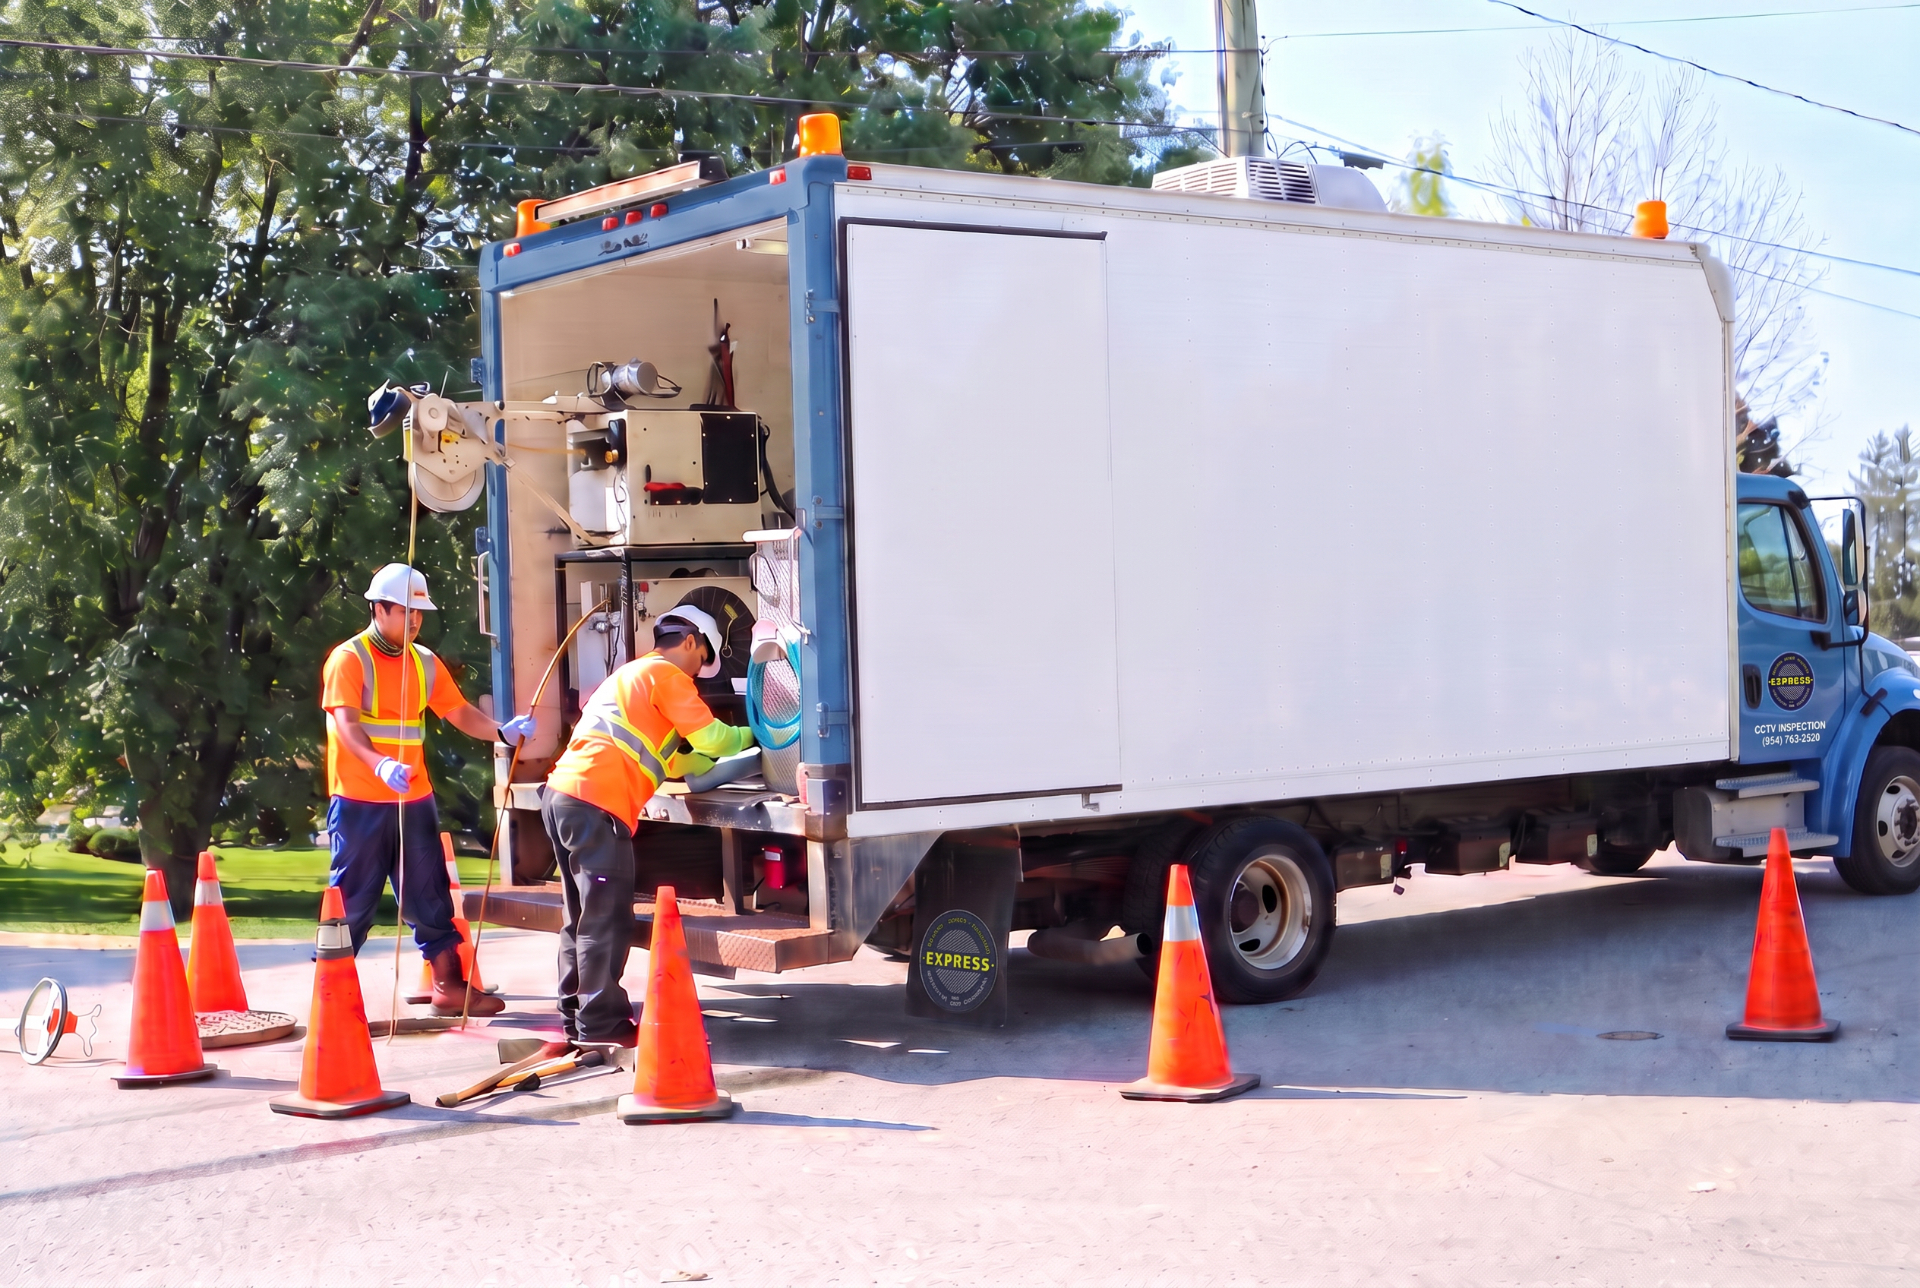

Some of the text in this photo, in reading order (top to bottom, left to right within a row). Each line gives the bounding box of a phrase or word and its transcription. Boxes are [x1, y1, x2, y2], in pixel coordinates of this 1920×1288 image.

[1754, 721, 1826, 735] CCTV INSPECTION
[1762, 733, 1821, 747] (954) 763-2520
[926, 951, 990, 972] EXPRESS
